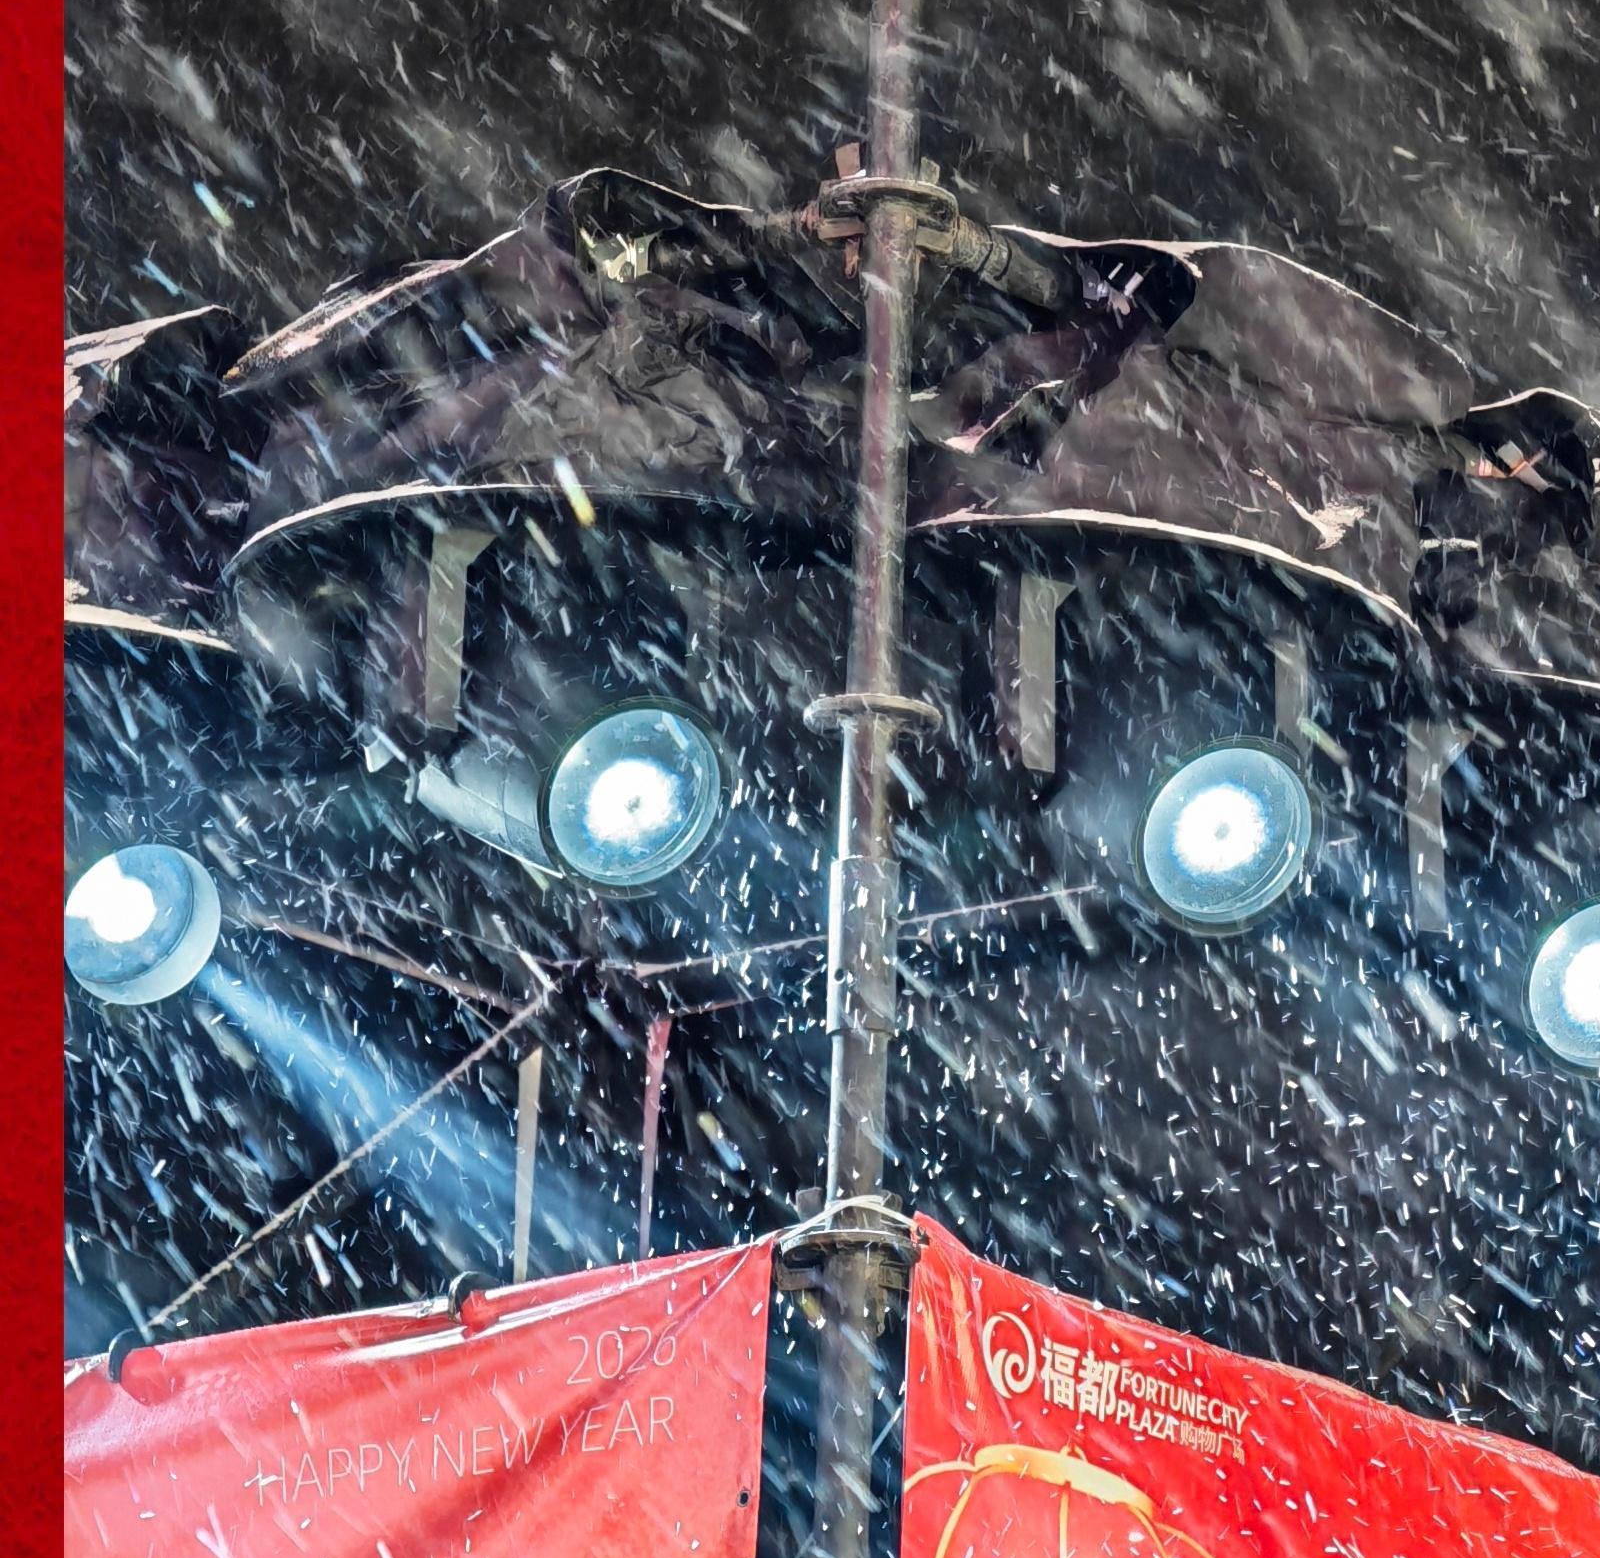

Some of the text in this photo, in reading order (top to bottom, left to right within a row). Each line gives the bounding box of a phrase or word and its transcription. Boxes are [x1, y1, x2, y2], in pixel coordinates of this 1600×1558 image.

[565, 1325, 678, 1385] 2026
[1040, 1337, 1120, 1423] 福都
[254, 1395, 677, 1507] HAPPY NEW YEAR
[1115, 1399, 1176, 1444] PLAZA
[1179, 1419, 1246, 1467] 购物广场
